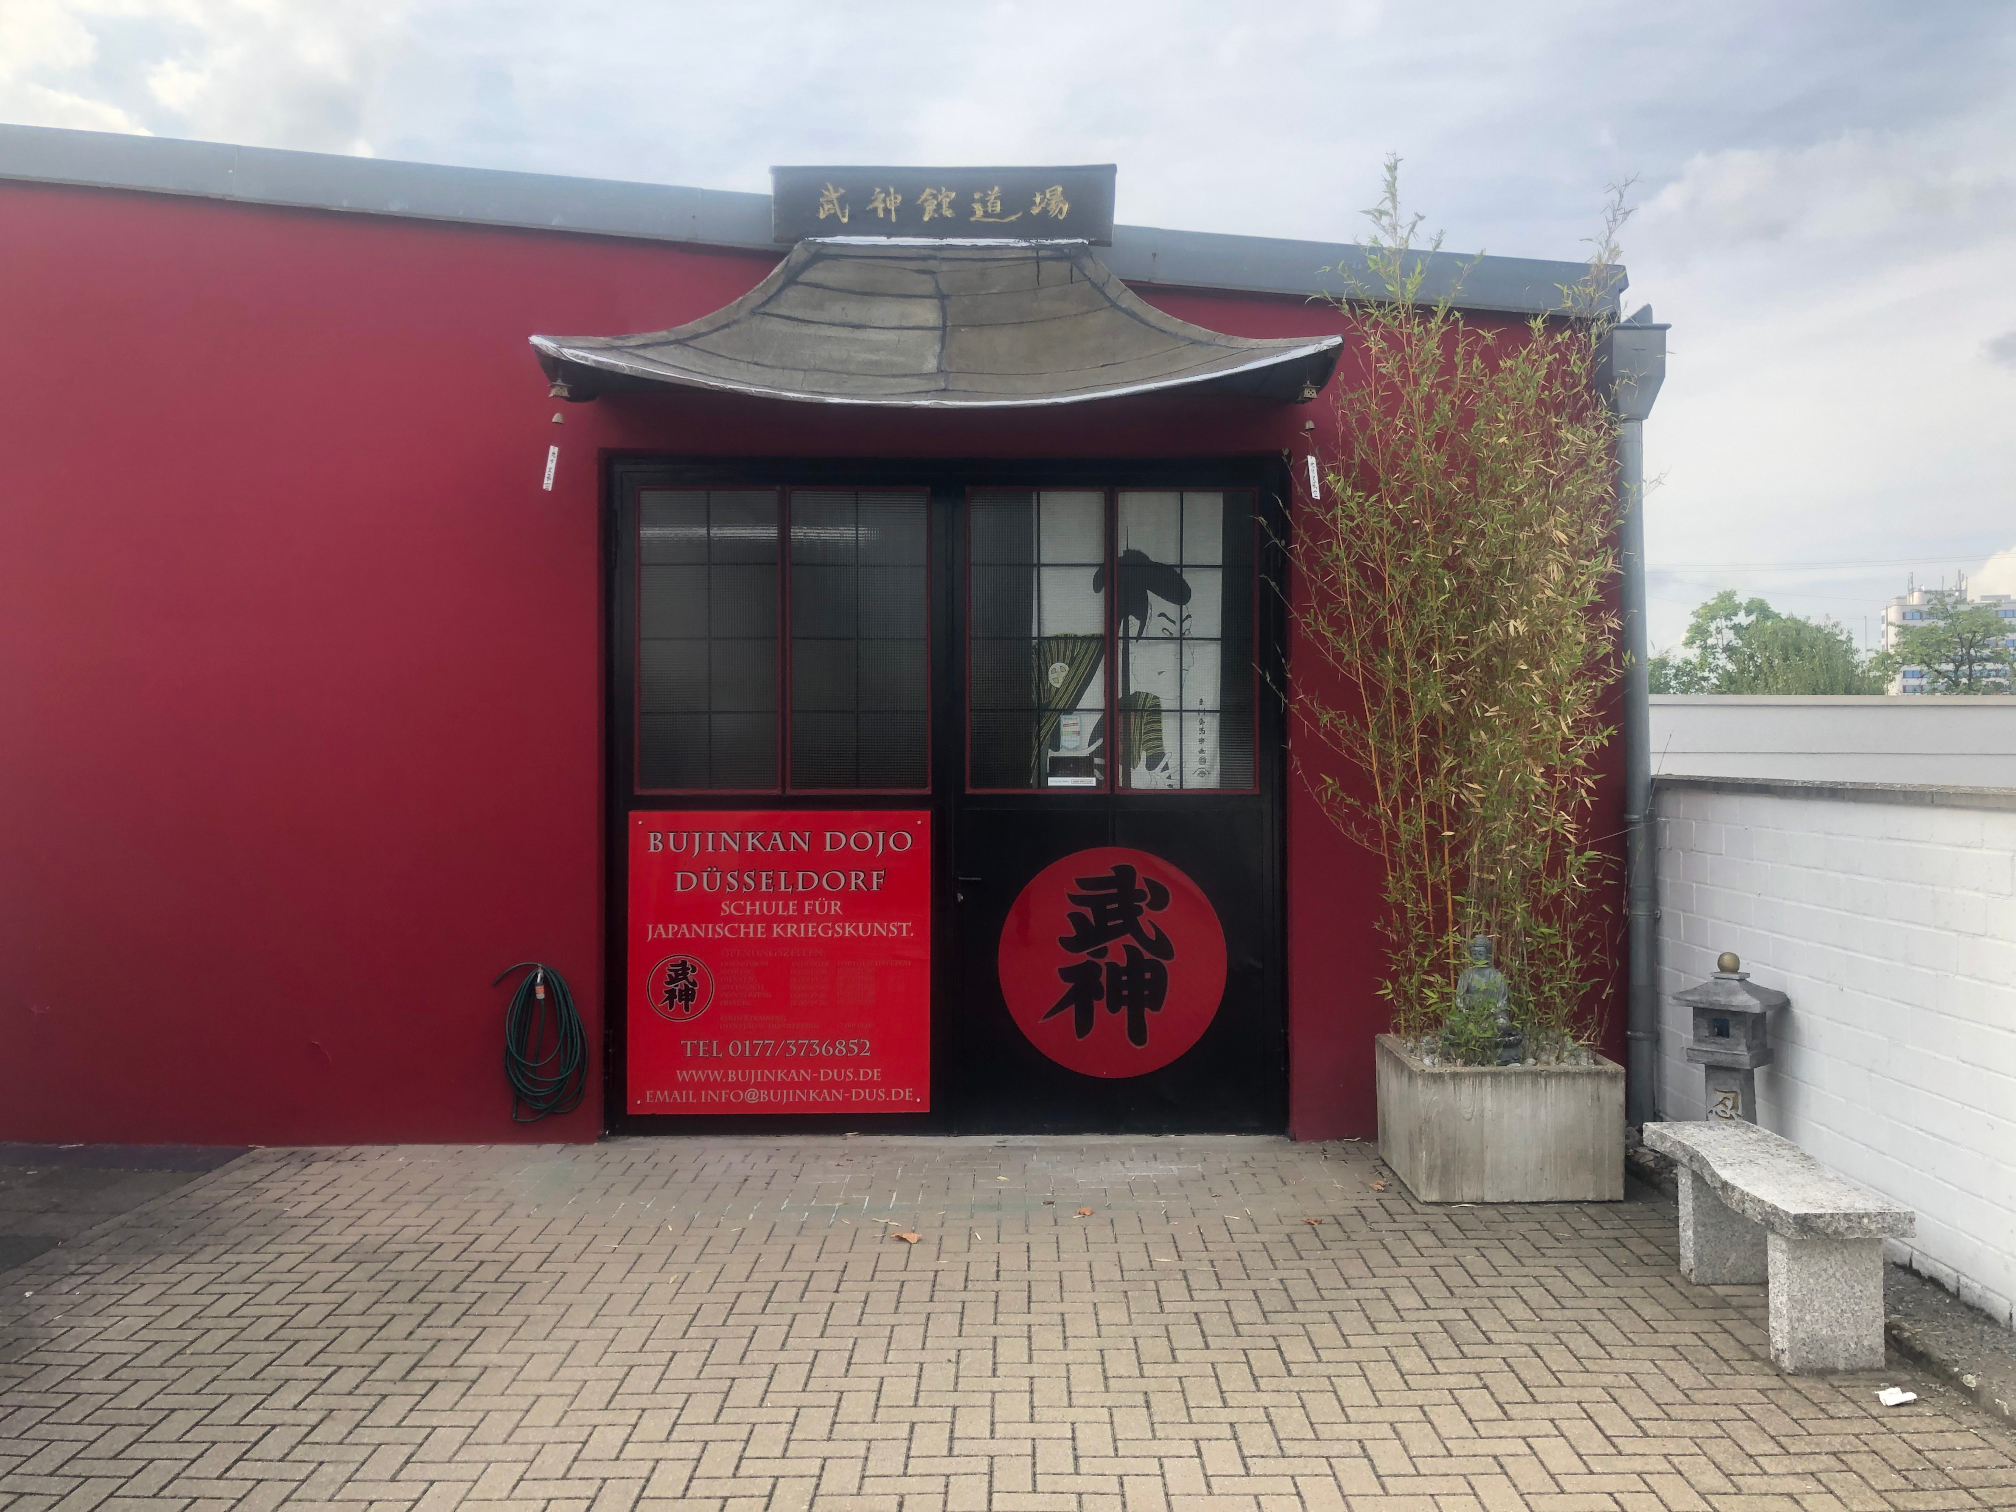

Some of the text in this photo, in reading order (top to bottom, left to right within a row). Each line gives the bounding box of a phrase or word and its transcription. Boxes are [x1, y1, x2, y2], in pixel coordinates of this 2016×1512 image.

[648, 831, 913, 859] BUJINKAN DOJO
[674, 866, 886, 894] DÜSSELDORF
[720, 897, 843, 917] SCHULE FÜR
[647, 921, 914, 942] JAPANISCHE KRIEGSKUNST.
[1038, 863, 1175, 1049] 武神
[658, 959, 699, 1014] 武神
[680, 1038, 872, 1058] TEL 0177/3736852
[676, 1067, 883, 1085] WWW.BUJINKAN-DUS.DE
[645, 1087, 915, 1107] EMAIL INFO@BUJINKAN-DUS.DE
